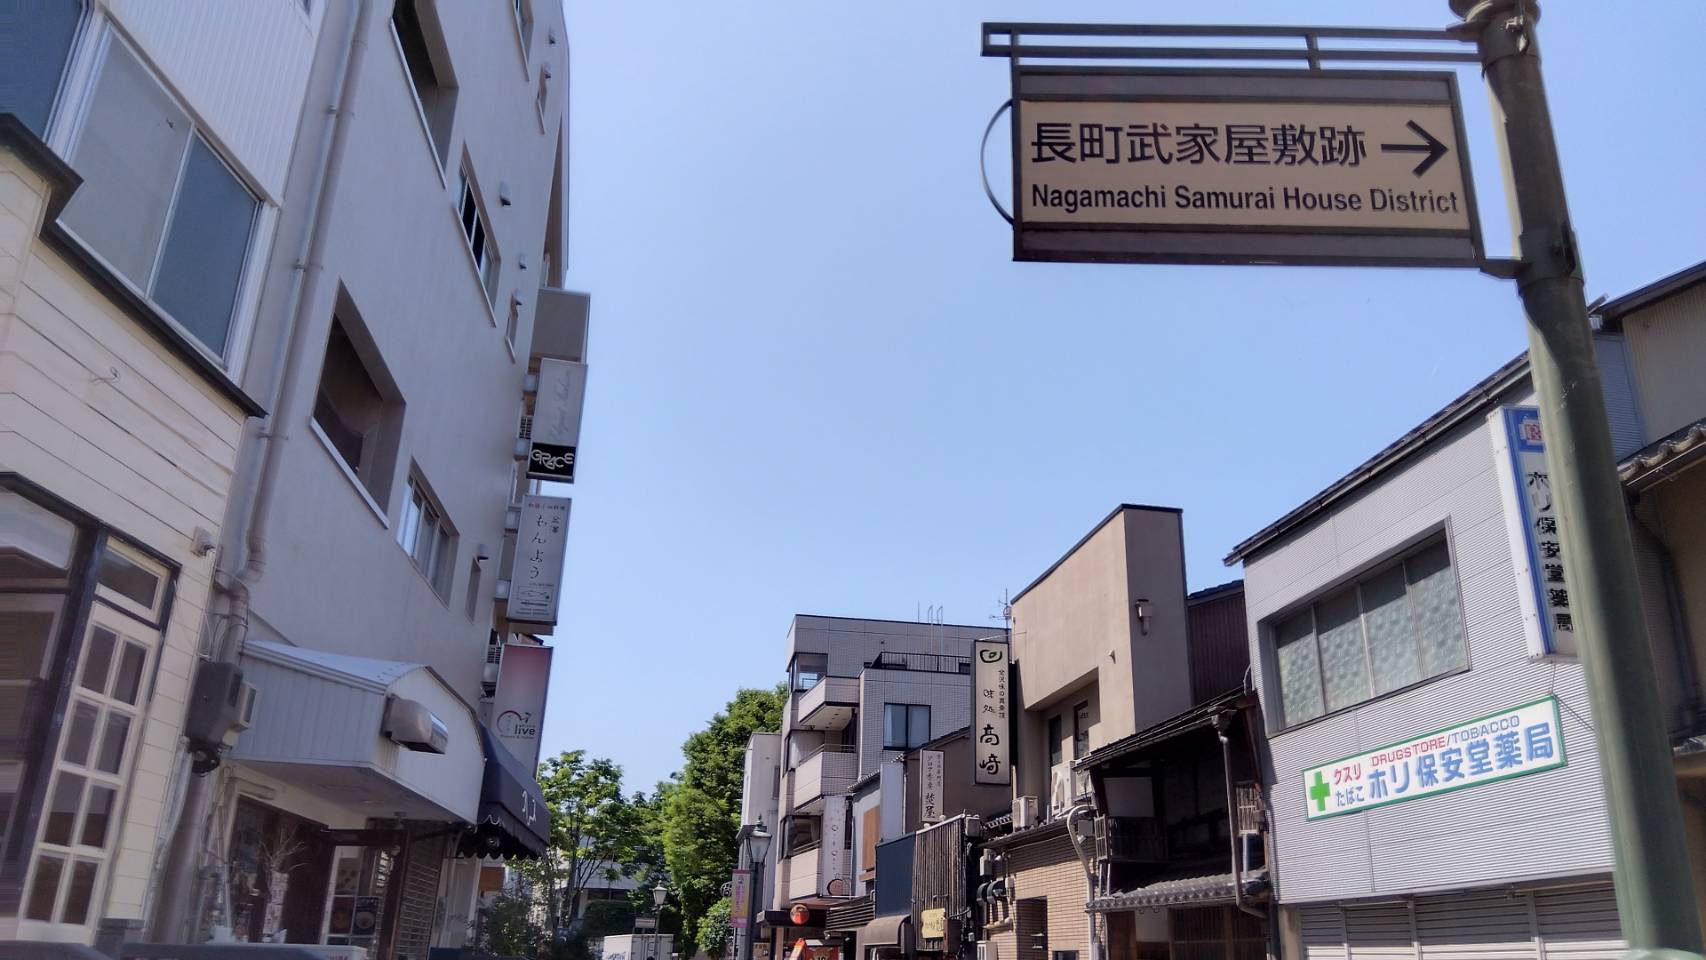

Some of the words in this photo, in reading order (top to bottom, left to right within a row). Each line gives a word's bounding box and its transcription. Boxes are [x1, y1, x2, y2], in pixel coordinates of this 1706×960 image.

[1031, 122, 1367, 167] 長町武家屋敷跡
[1032, 184, 1167, 213] Nagamachi
[1175, 185, 1275, 210] Samurai
[1283, 187, 1362, 210] House
[1370, 188, 1458, 213] District
[1371, 715, 1520, 767] DRUGSTORE/TOBACCO
[1333, 762, 1362, 785] クスリ
[1368, 721, 1554, 799] ホリ保安堂薬局
[1335, 785, 1365, 808] たばこ
